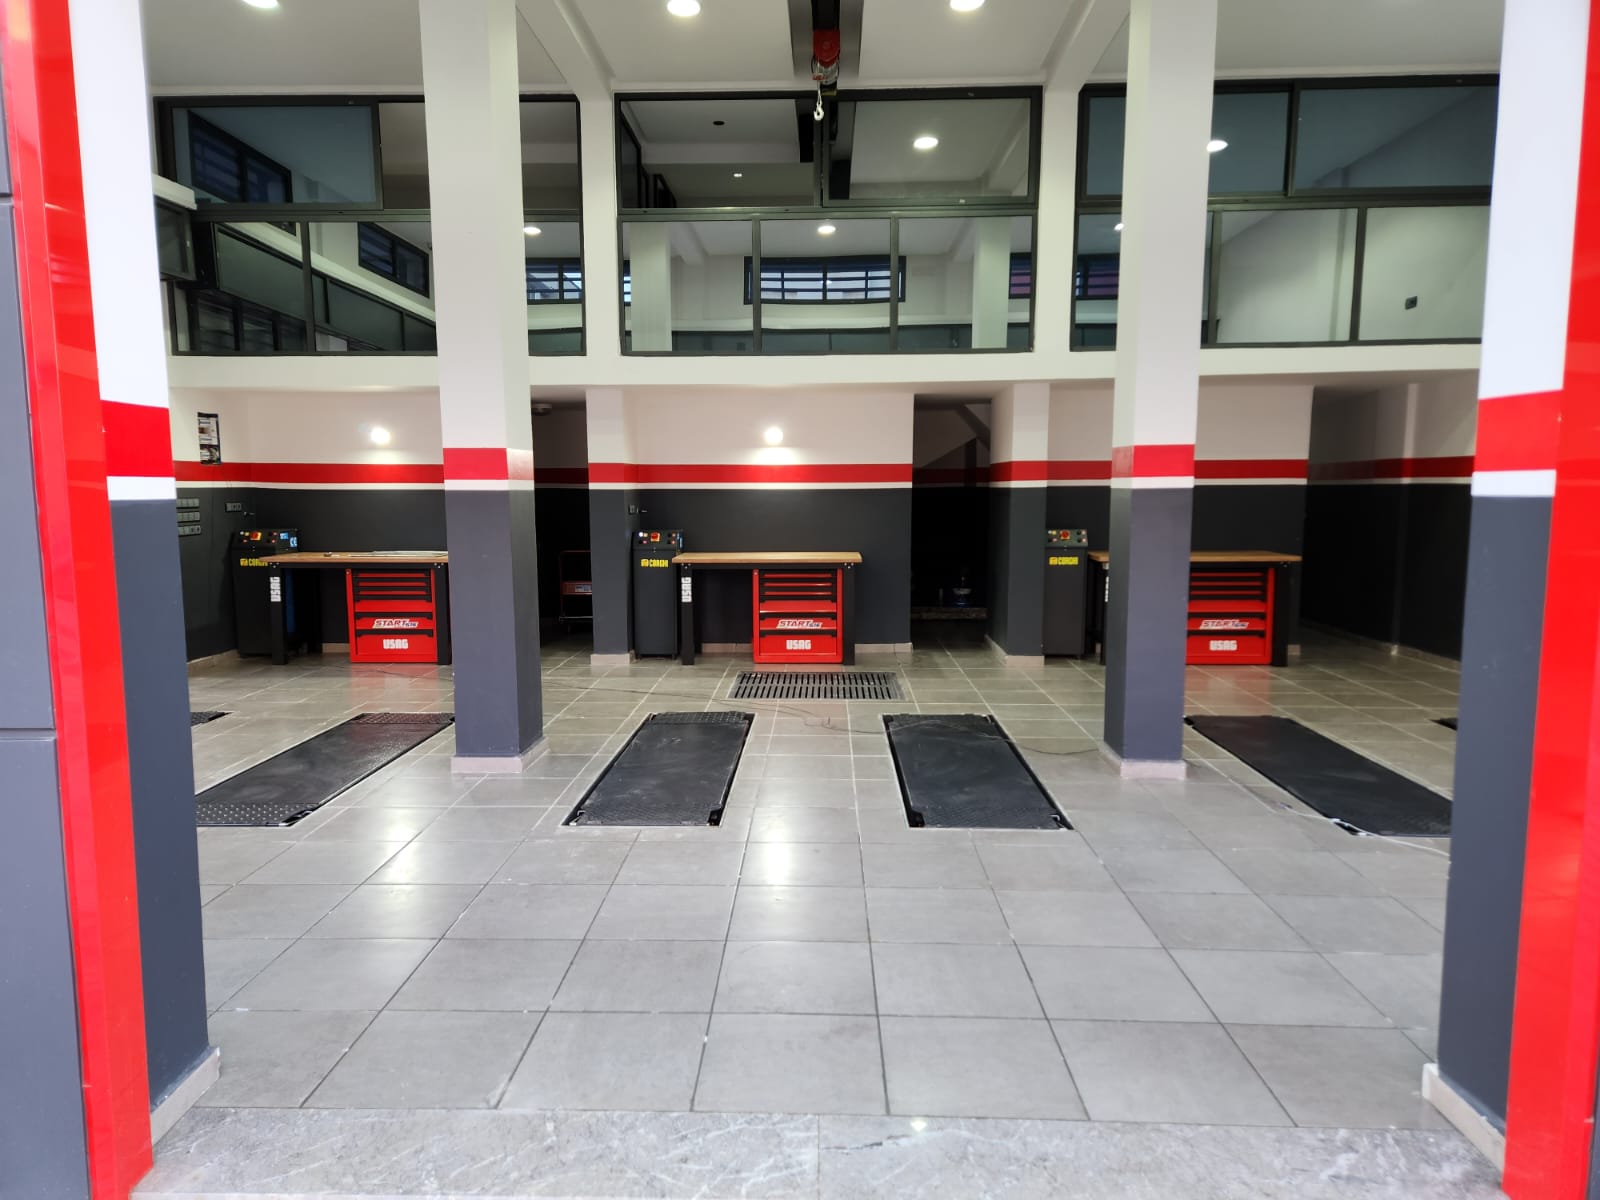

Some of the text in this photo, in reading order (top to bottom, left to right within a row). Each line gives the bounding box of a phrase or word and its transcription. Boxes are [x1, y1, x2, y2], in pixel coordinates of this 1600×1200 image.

[270, 576, 281, 602] USAG
[681, 577, 692, 603] USAG
[375, 619, 407, 628] START
[779, 619, 811, 628] START
[383, 639, 409, 649] USAG
[786, 640, 811, 650] USAG
